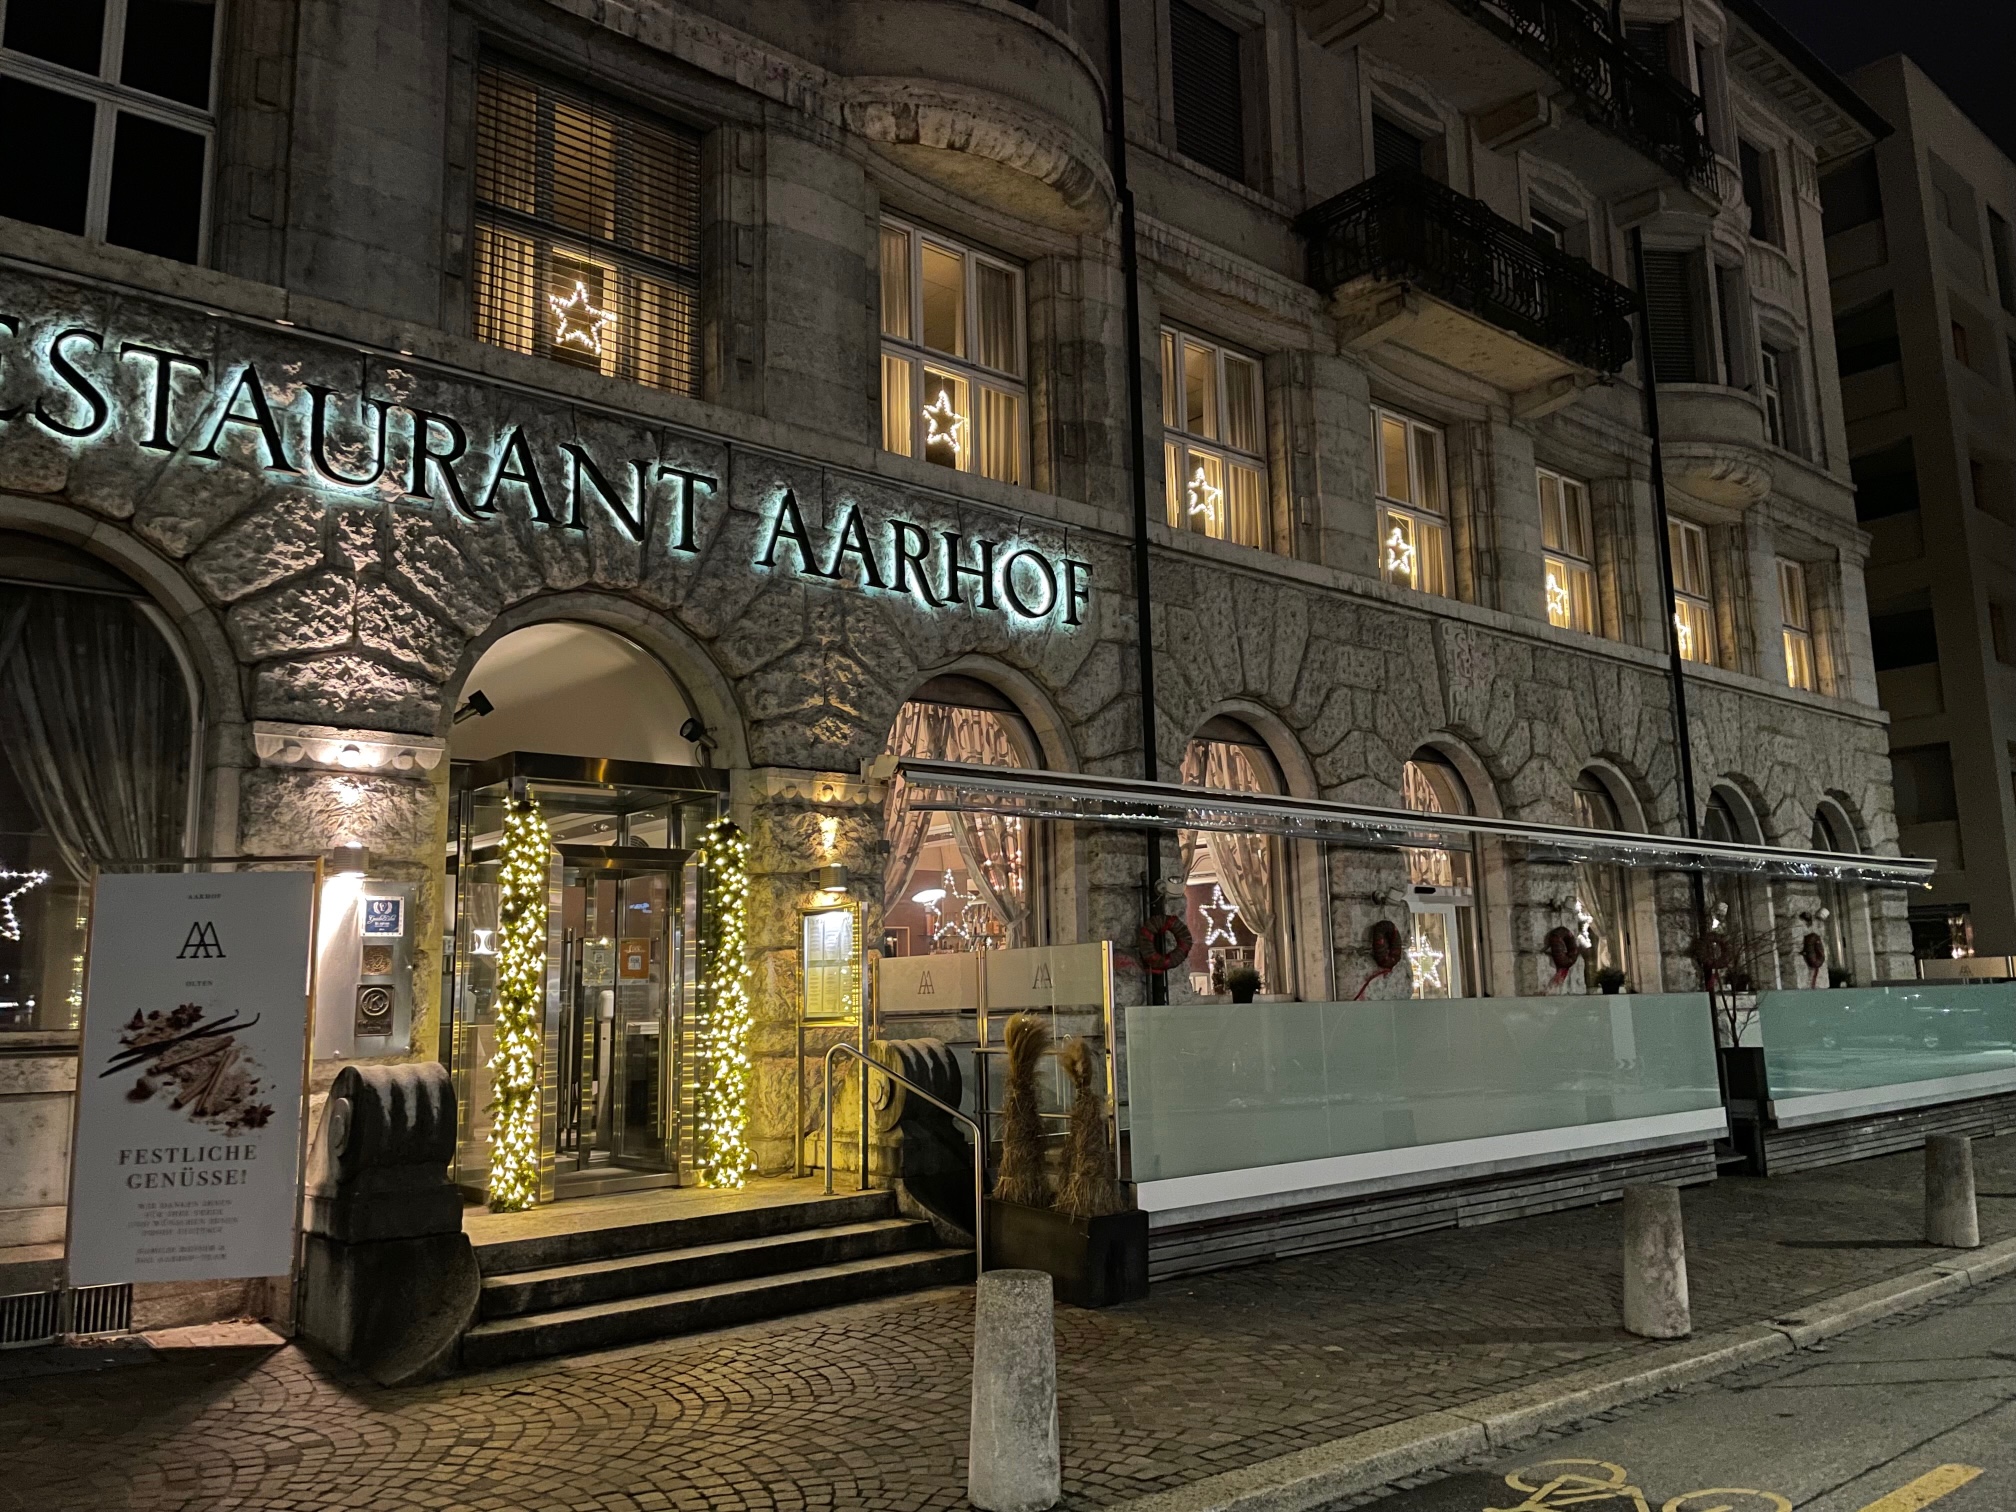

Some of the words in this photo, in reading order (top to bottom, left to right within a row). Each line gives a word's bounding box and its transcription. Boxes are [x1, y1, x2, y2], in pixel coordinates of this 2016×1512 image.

[754, 488, 1093, 626] AARHOF
[118, 1144, 257, 1166] FESTLICHE
[126, 1167, 247, 1190] GENÜSSE!
